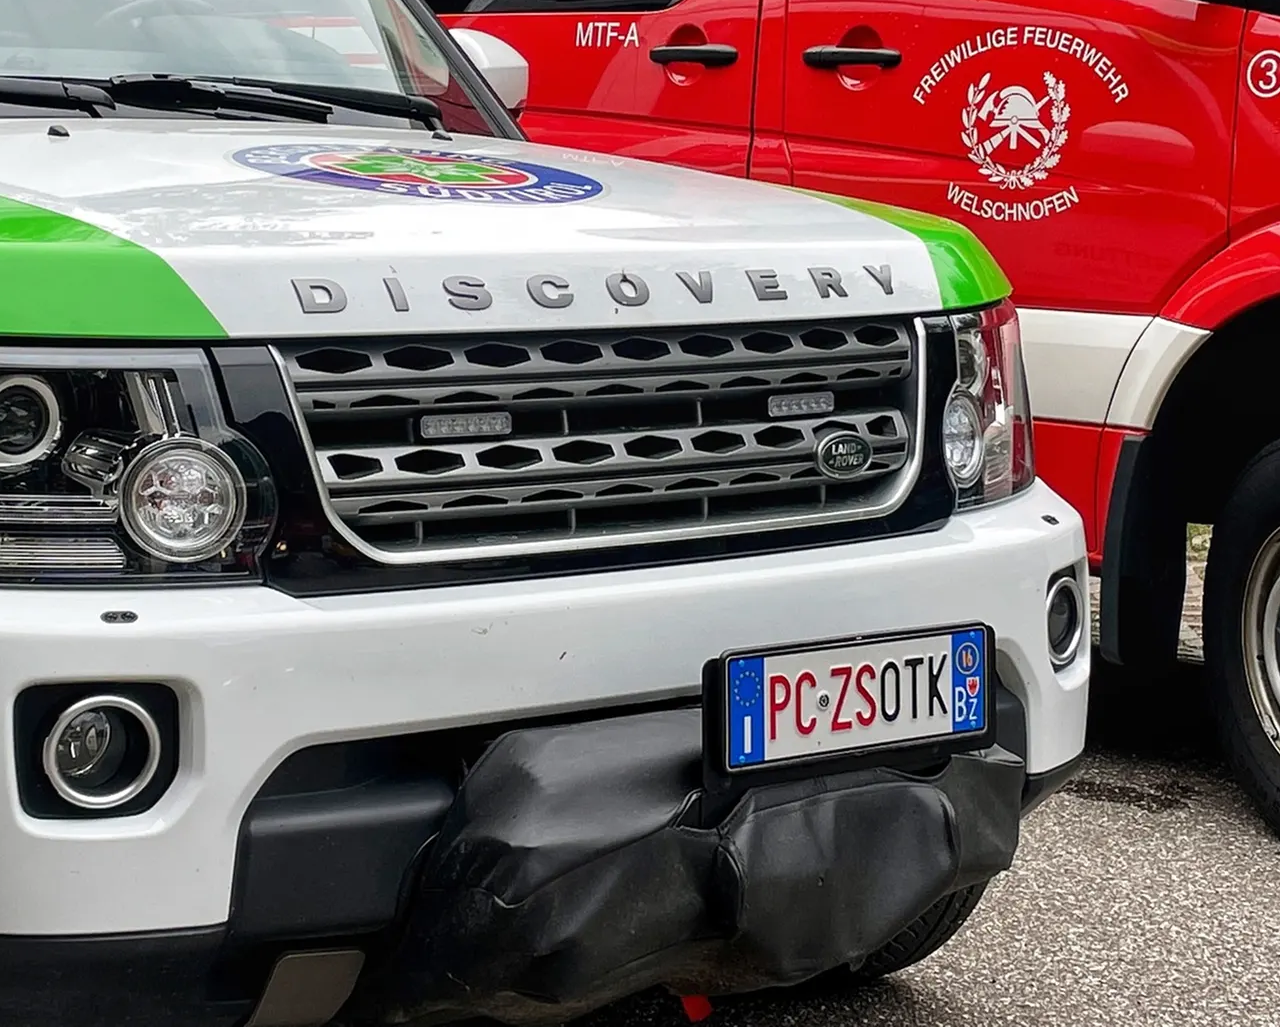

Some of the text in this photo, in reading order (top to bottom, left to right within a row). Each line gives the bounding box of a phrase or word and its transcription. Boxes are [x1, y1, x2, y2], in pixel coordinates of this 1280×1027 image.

[575, 21, 640, 48] MTF-A
[912, 26, 1130, 105] FREIWILLIGE FEUERWEHR
[1258, 58, 1278, 90] 3
[946, 181, 1080, 221] WELSCHNOFEN
[290, 263, 896, 314] DISCOVERY
[831, 443, 857, 455] LAND
[834, 454, 864, 467] ROVER
